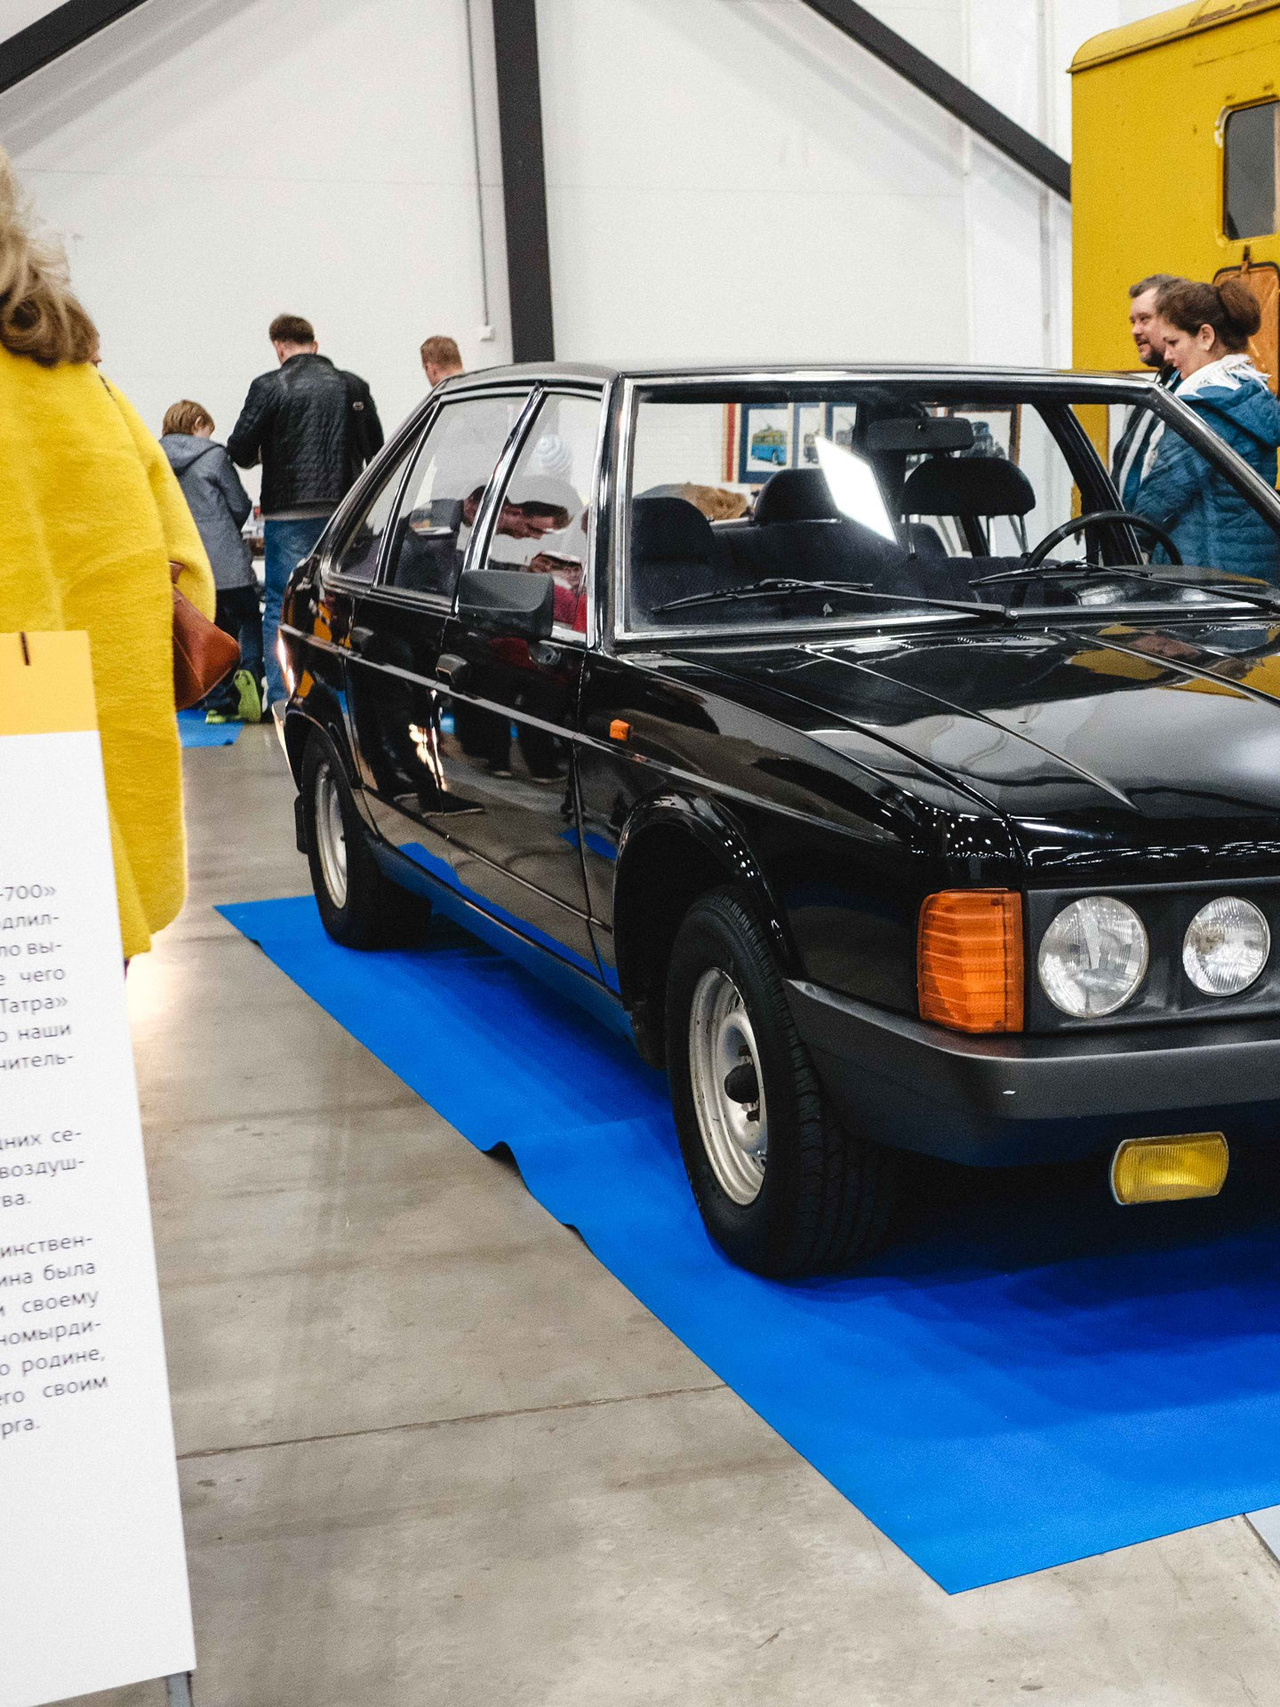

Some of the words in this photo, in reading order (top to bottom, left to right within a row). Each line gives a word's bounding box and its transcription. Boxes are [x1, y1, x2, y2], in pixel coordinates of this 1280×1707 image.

[0, 884, 57, 901] -700»
[27, 942, 62, 955] вы-
[20, 968, 66, 983] чего
[0, 997, 67, 1015] Татра»
[18, 1024, 72, 1041] наши
[0, 1133, 42, 1151] них
[51, 1129, 82, 1143] се-
[0, 1158, 84, 1179] воздуш-
[0, 1236, 93, 1258] инствен-
[43, 1262, 96, 1281] была
[22, 1291, 99, 1314] своему
[22, 1348, 105, 1377] родине,
[43, 1376, 109, 1398] своим
